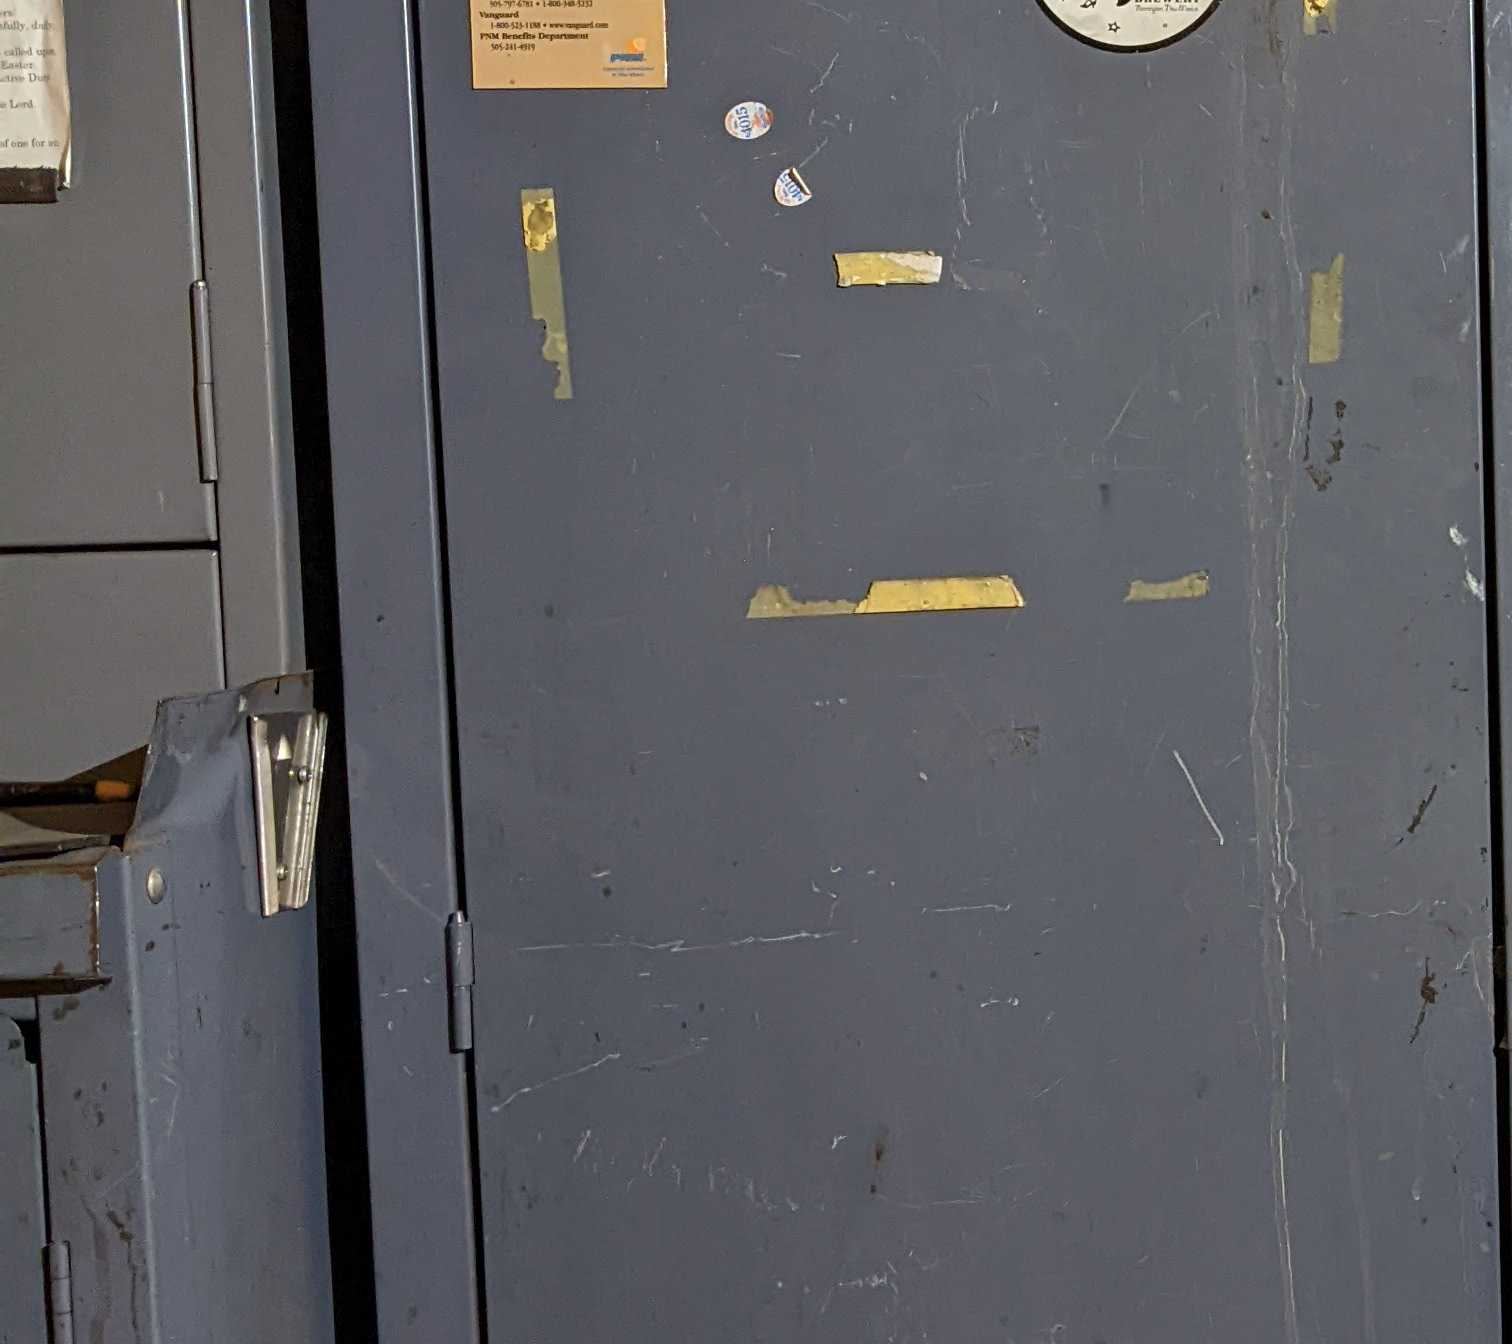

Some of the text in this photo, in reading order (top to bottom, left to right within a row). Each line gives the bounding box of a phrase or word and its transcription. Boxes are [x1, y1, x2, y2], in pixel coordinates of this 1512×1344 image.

[479, 11, 519, 20] Vanguard
[502, 32, 589, 42] Benefits Department
